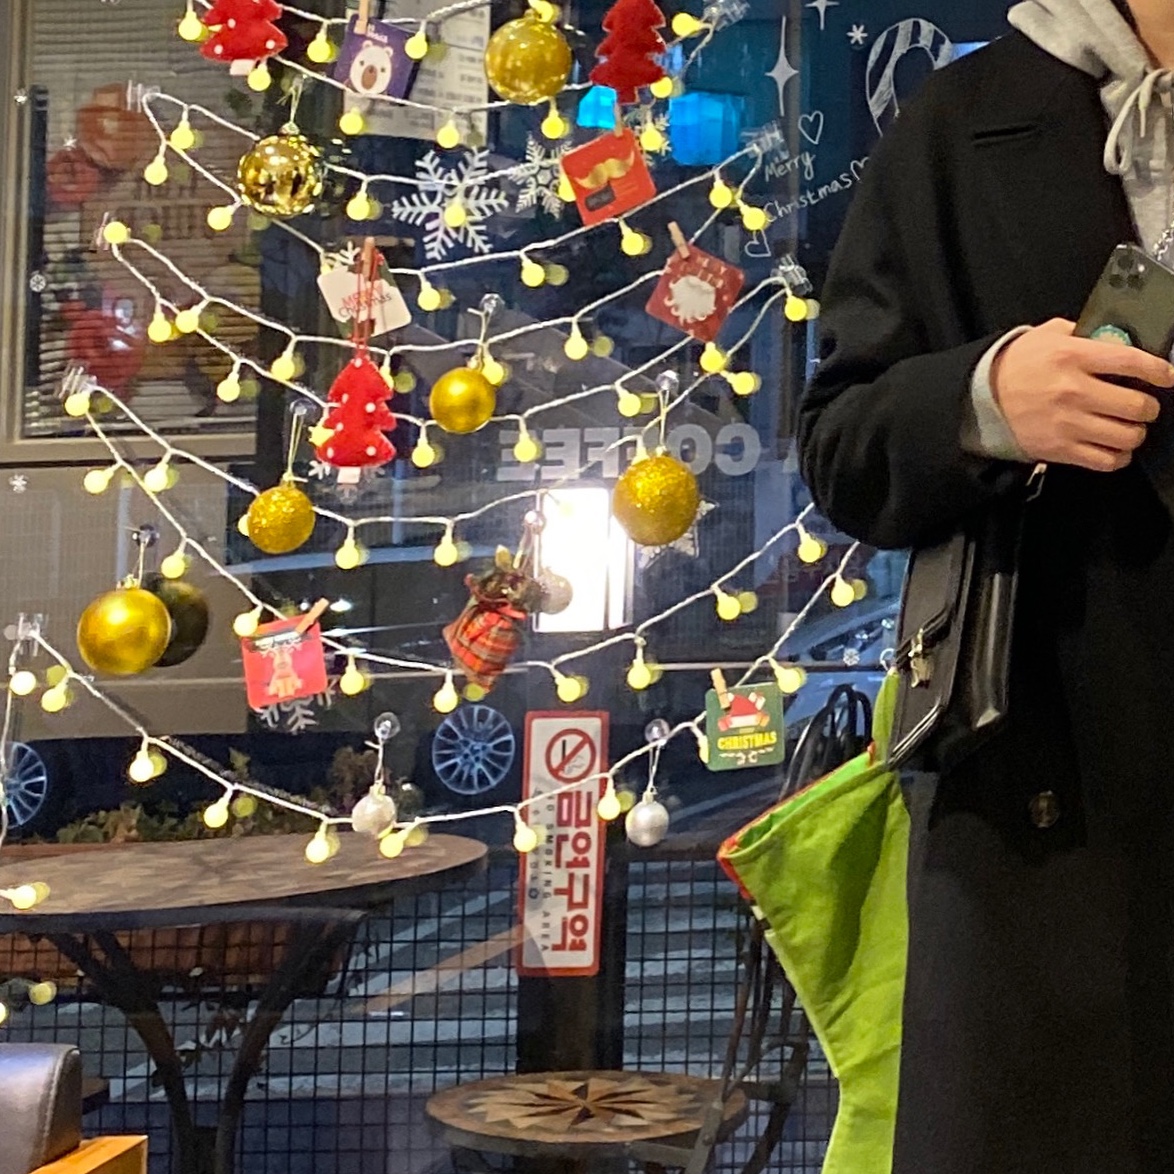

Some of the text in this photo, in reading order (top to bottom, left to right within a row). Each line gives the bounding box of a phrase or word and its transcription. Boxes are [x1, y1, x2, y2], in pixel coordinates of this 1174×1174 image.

[765, 151, 816, 182] Merry
[763, 172, 853, 222] Christmas
[543, 823, 554, 899] SMOKING
[552, 790, 593, 951] 금연구역
[540, 910, 551, 951] AREA
